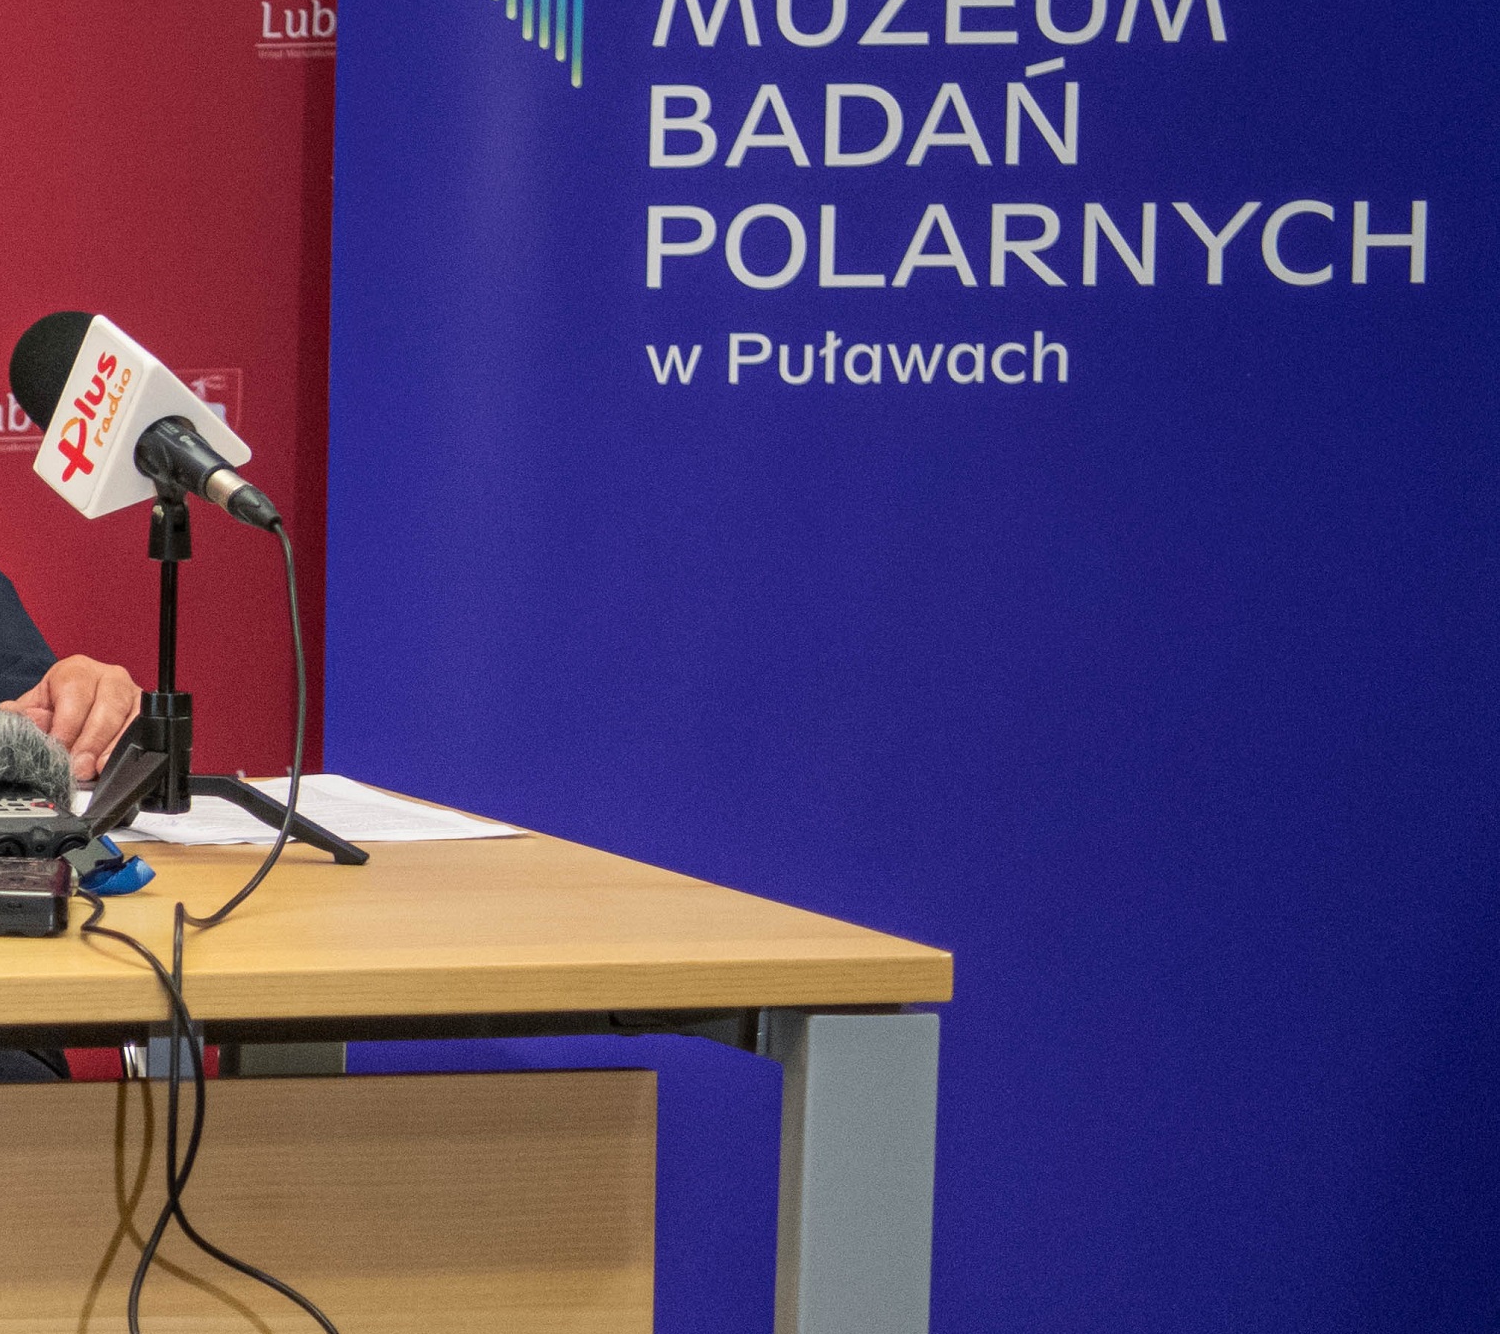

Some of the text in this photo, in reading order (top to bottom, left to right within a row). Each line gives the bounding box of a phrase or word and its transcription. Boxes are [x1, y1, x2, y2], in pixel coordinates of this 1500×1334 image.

[649, 56, 1079, 169] BADAŃ
[646, 199, 1427, 290] POLARNYCH
[645, 330, 1069, 385] w Puławach
[93, 368, 132, 448] radio
